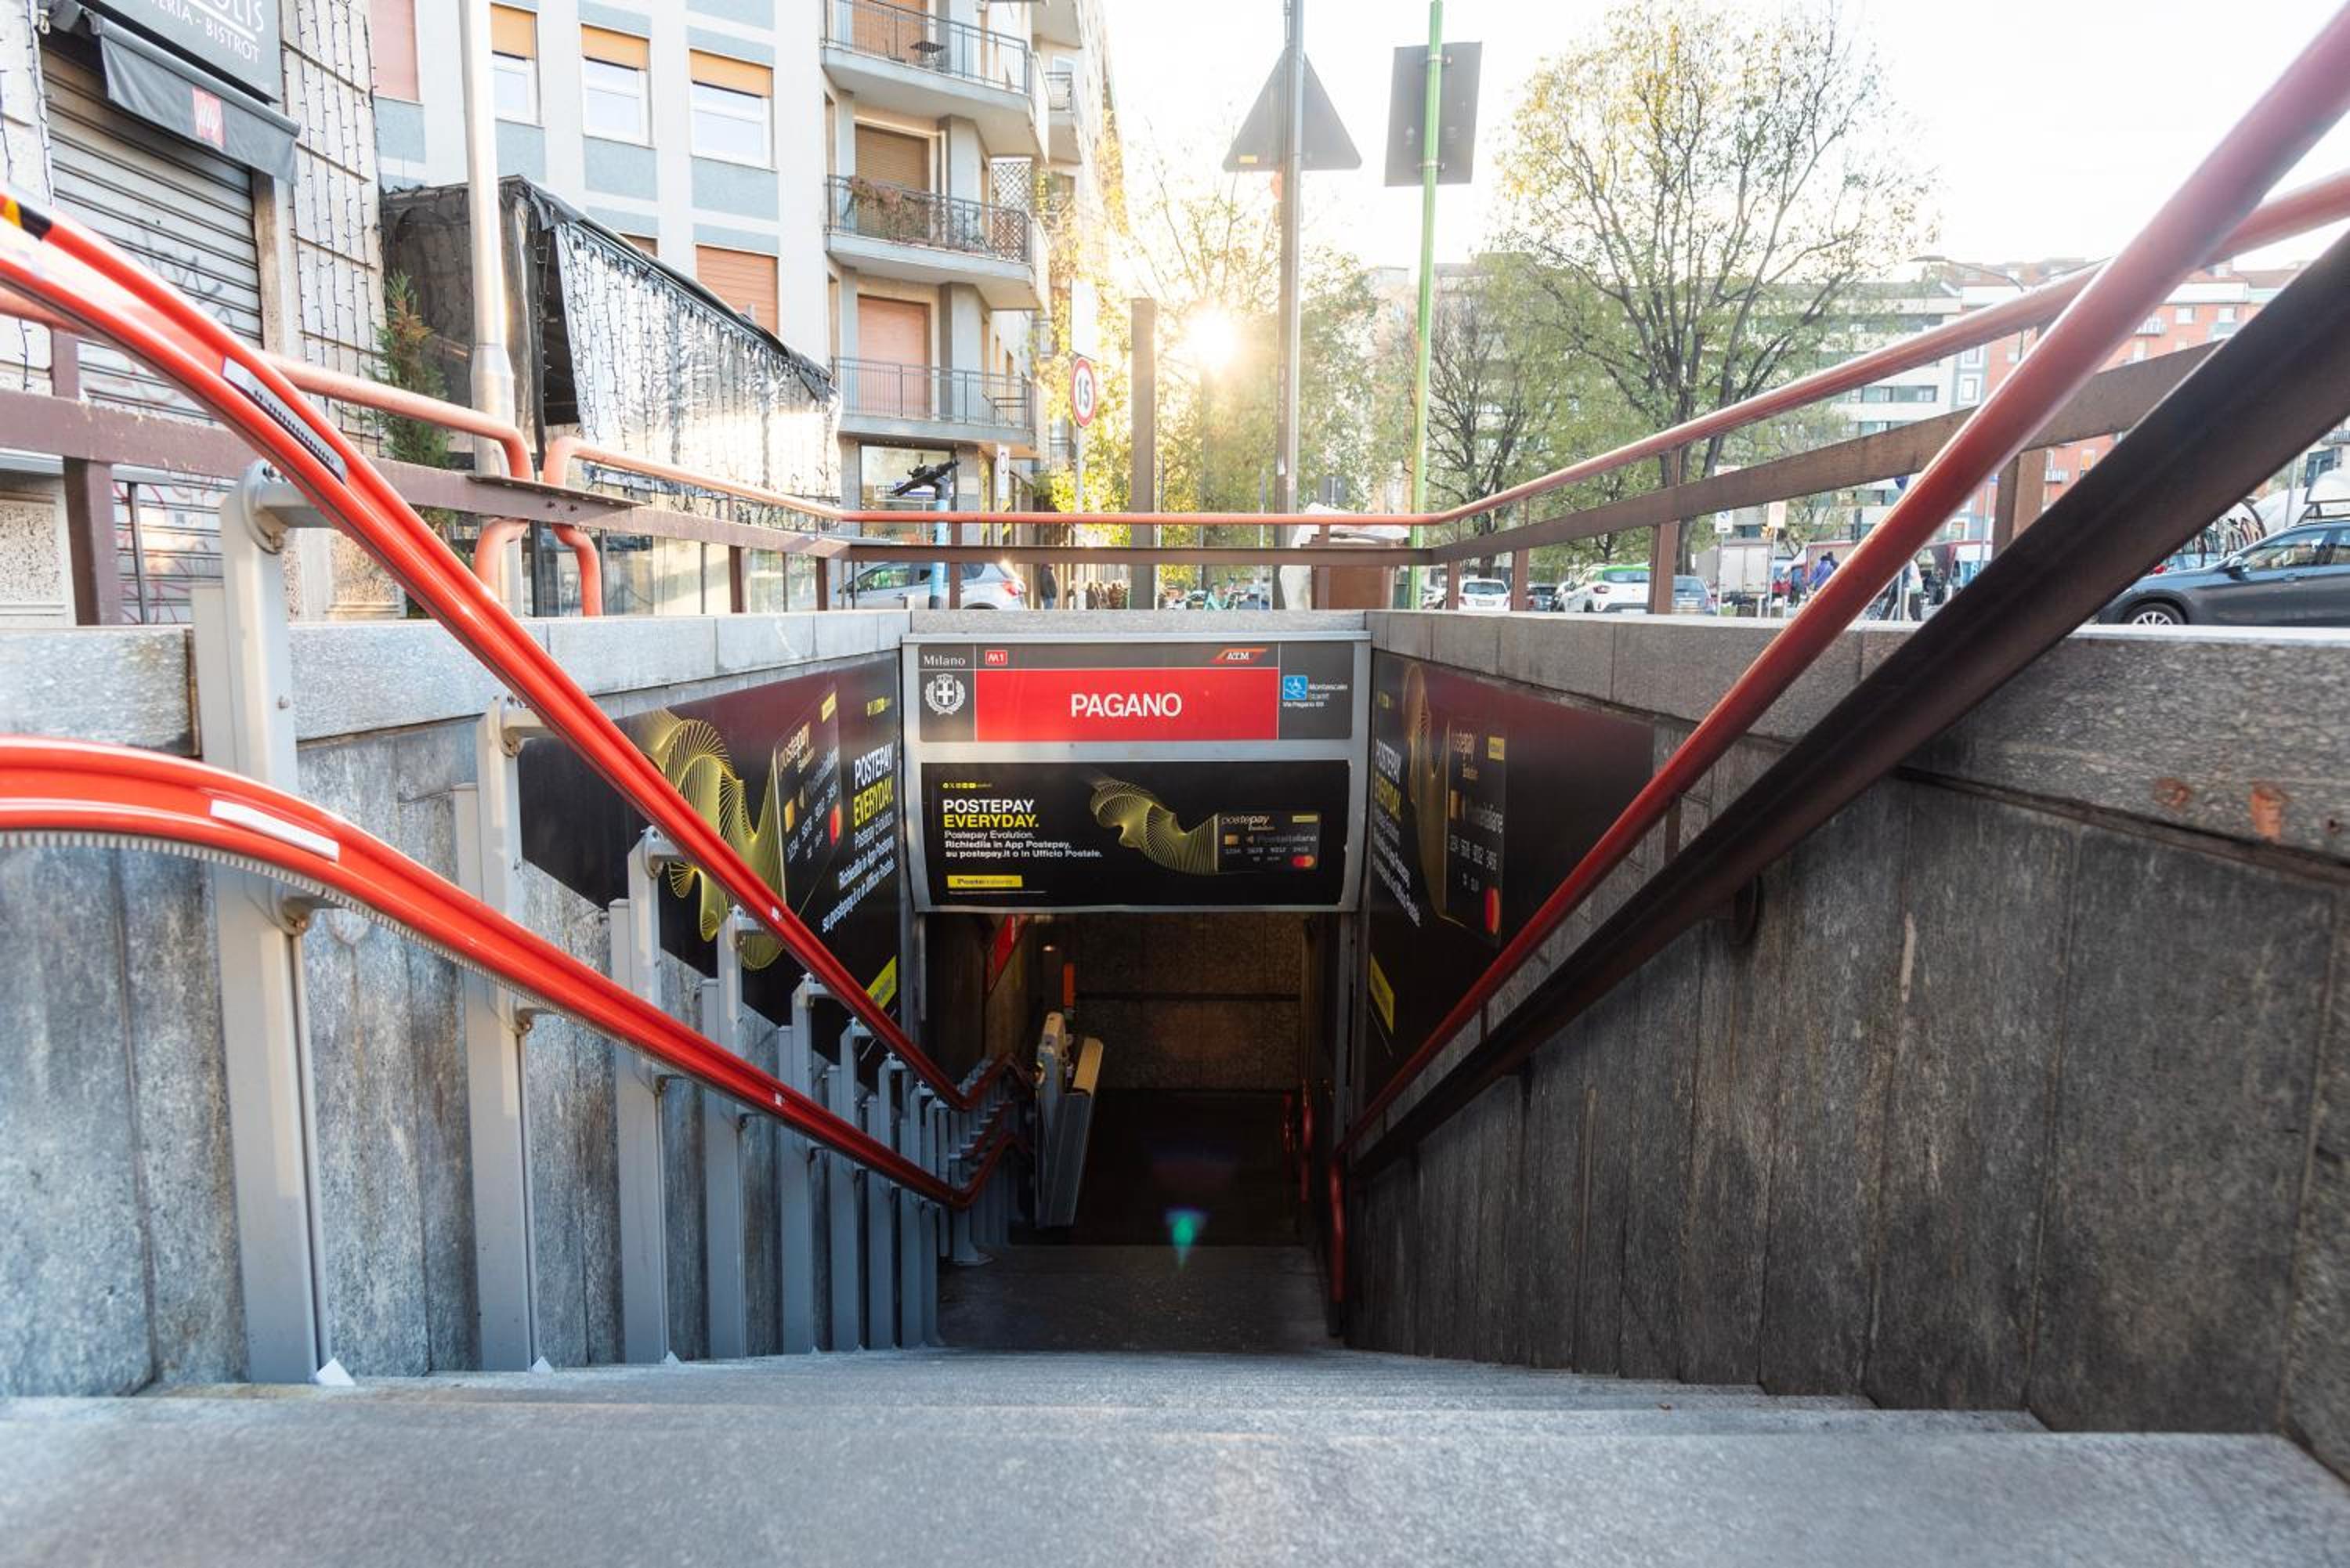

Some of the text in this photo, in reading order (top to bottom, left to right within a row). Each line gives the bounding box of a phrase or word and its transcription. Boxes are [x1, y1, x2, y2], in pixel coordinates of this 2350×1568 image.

[206, 16, 260, 63] BISTROT
[1078, 378, 1090, 408] 15
[924, 655, 966, 666] Milano
[987, 653, 1005, 663] M1
[1227, 652, 1249, 660] ATM
[1070, 693, 1183, 717] PAGANO
[855, 742, 894, 790] POSTEPAY
[942, 799, 1034, 813] POSTEPAY
[944, 814, 1039, 828] EVERYDAY.
[944, 830, 1036, 840] Postepay Evolution.
[1004, 840, 1024, 850] App
[1026, 840, 1071, 850] Postepay,
[960, 850, 1010, 859] postepay.it
[1065, 849, 1103, 858] Postale.
